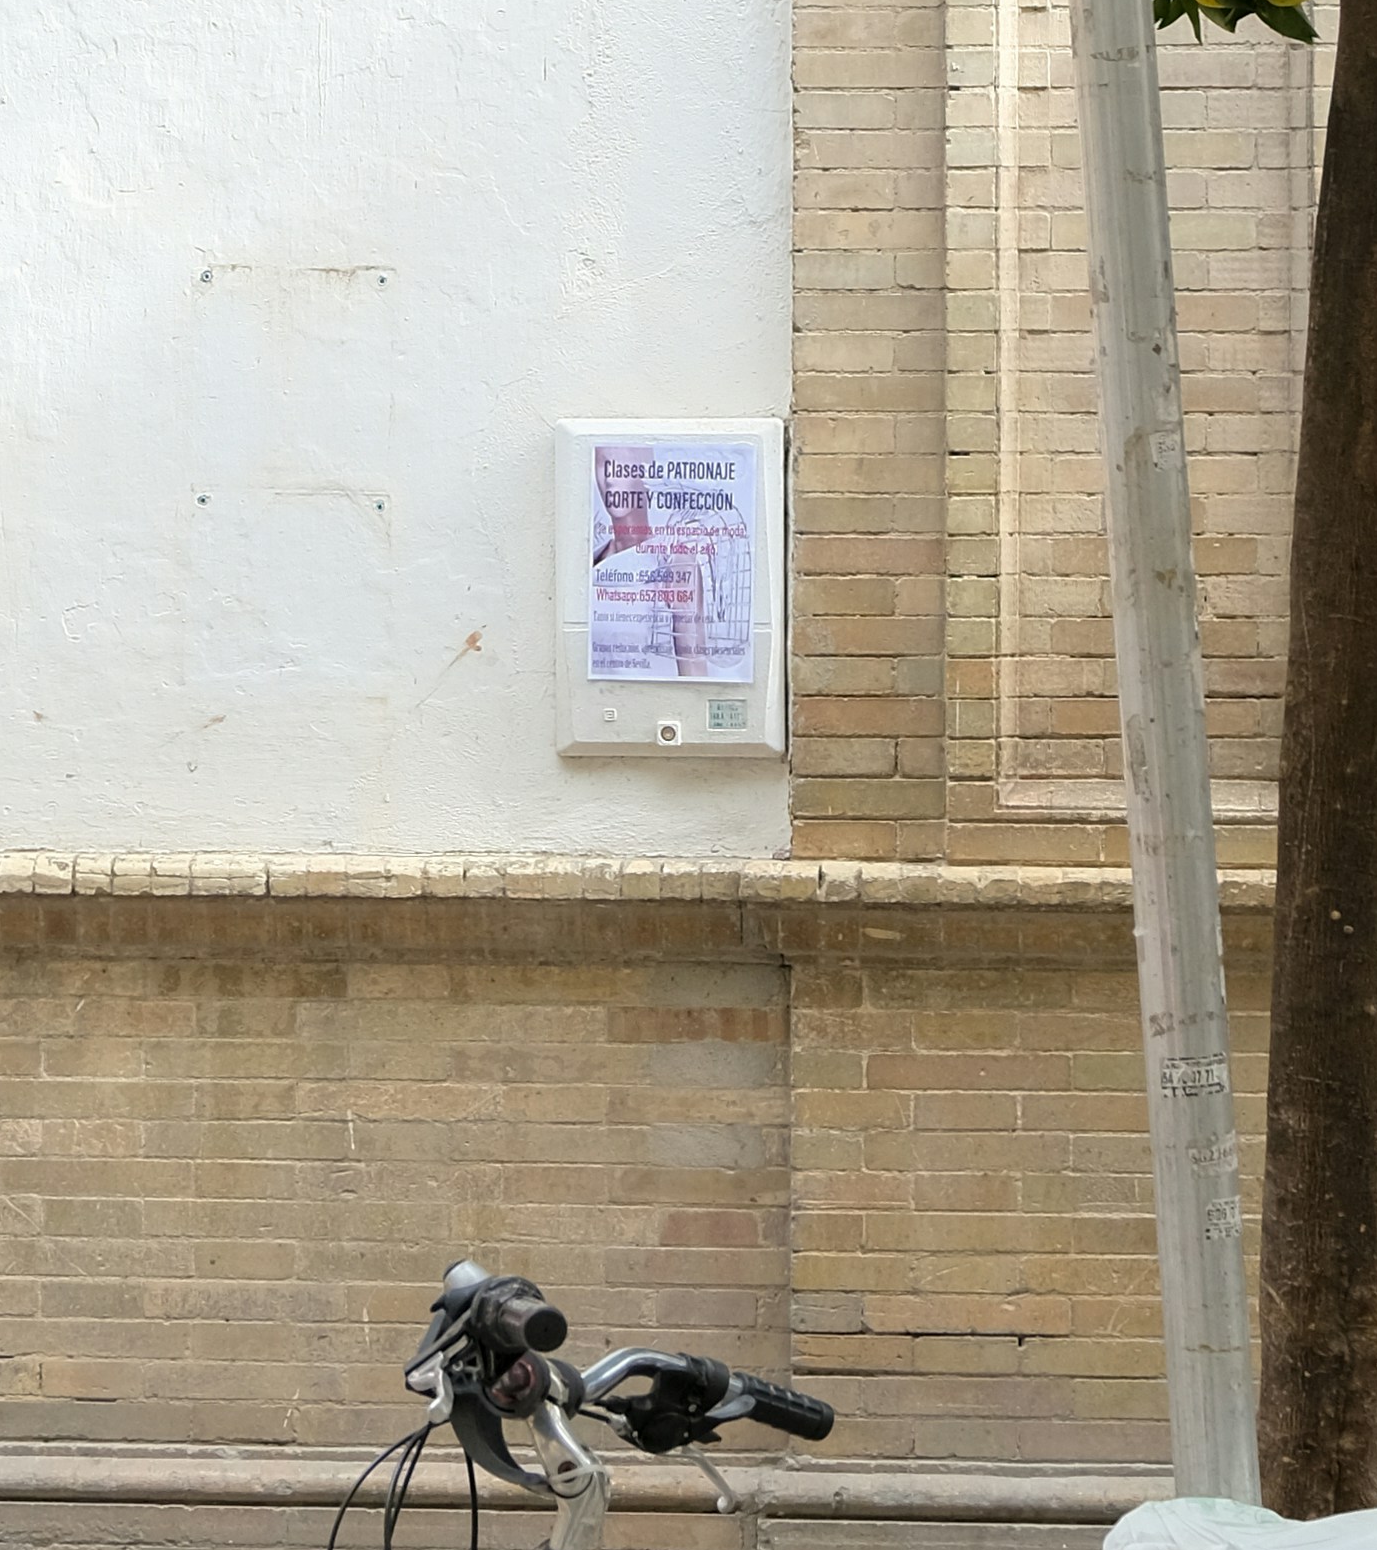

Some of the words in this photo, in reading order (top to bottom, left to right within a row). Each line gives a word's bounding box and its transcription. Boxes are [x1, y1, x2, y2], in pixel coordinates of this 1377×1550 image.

[604, 459, 645, 479] Clases
[648, 460, 664, 479] de
[666, 461, 736, 480] PATRONAJE
[605, 490, 644, 510] CORTE
[646, 491, 655, 509] Y
[656, 488, 734, 511] CONFECCIÓN
[596, 569, 634, 582] Teléfono
